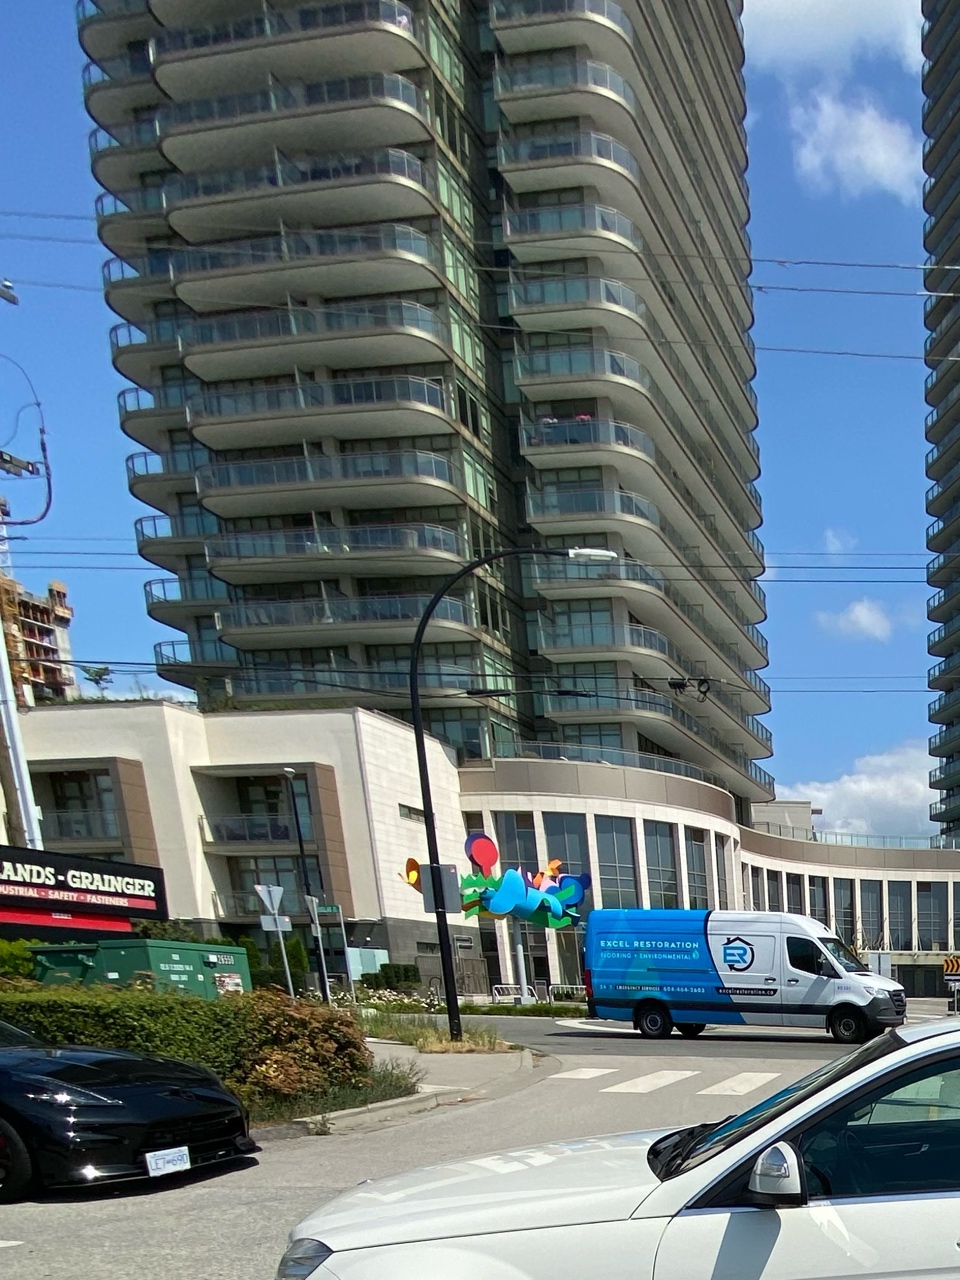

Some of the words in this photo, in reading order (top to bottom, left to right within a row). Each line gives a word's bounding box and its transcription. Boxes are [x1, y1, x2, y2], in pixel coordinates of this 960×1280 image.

[0, 861, 55, 885] ANDS
[66, 869, 156, 897] GRAINGER
[0, 884, 40, 897] USTRIAL
[48, 890, 78, 901] SAFETY
[87, 894, 128, 906] FASTENERS
[600, 940, 630, 948] EXCEL
[633, 941, 699, 949] RESTORATION
[723, 945, 748, 964] ER
